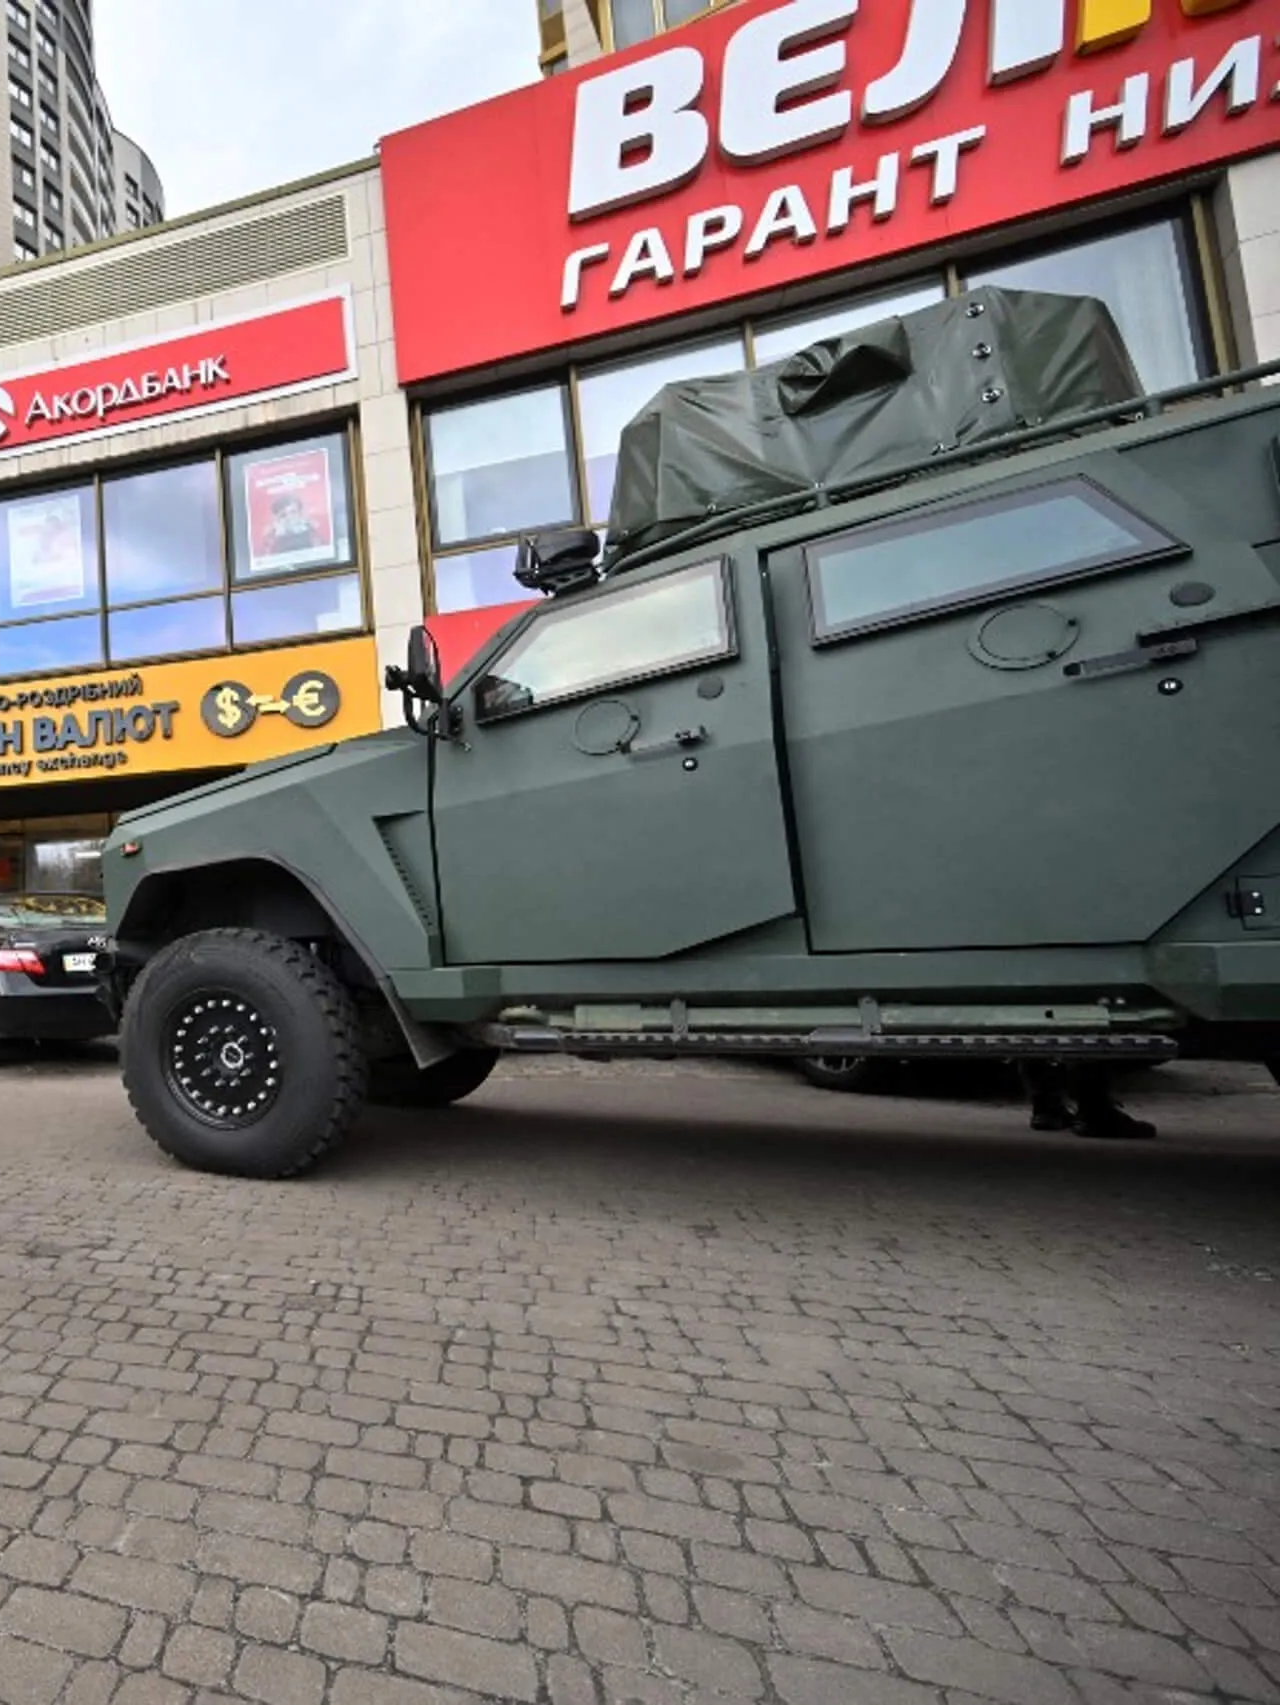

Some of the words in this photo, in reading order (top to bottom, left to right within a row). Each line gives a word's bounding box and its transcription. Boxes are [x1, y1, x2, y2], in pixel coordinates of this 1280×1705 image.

[559, 124, 987, 311] ГАРАНТ
[1060, 34, 1280, 166] НИ
[568, 0, 1252, 223] ВЕЛ
[33, 700, 179, 753] ВАЛЮТ
[37, 750, 128, 772] exchange
